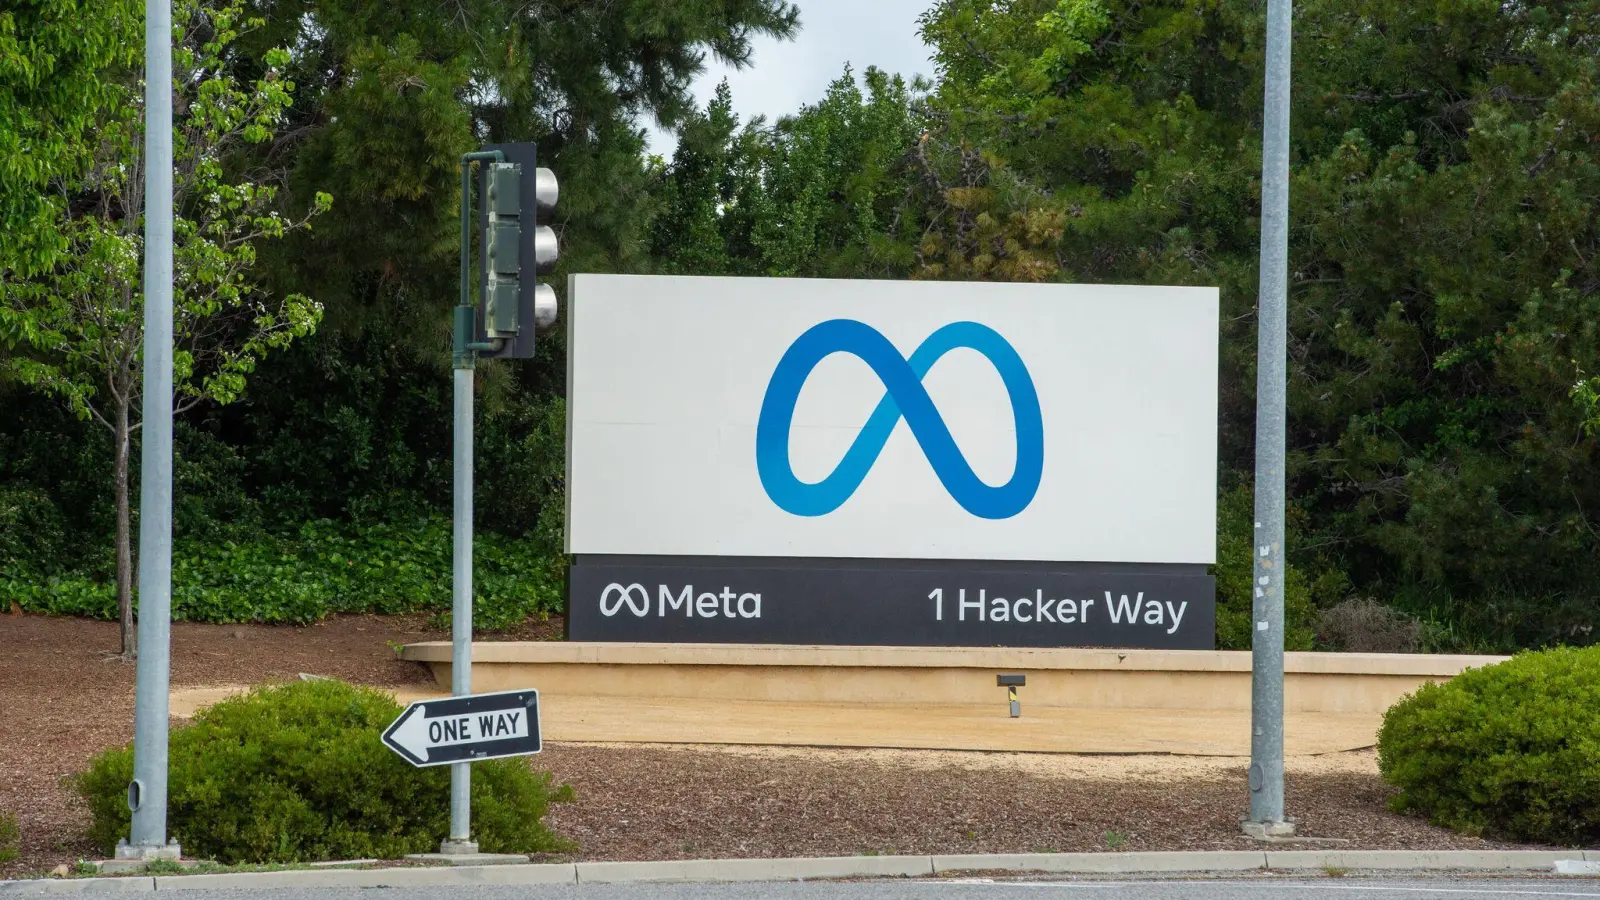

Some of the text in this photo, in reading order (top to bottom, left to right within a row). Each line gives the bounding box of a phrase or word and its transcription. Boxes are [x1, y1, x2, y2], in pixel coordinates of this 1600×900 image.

[658, 584, 762, 618] Meta
[927, 588, 1188, 634] 1 Hacker Way
[428, 712, 521, 744] ONE WAY
